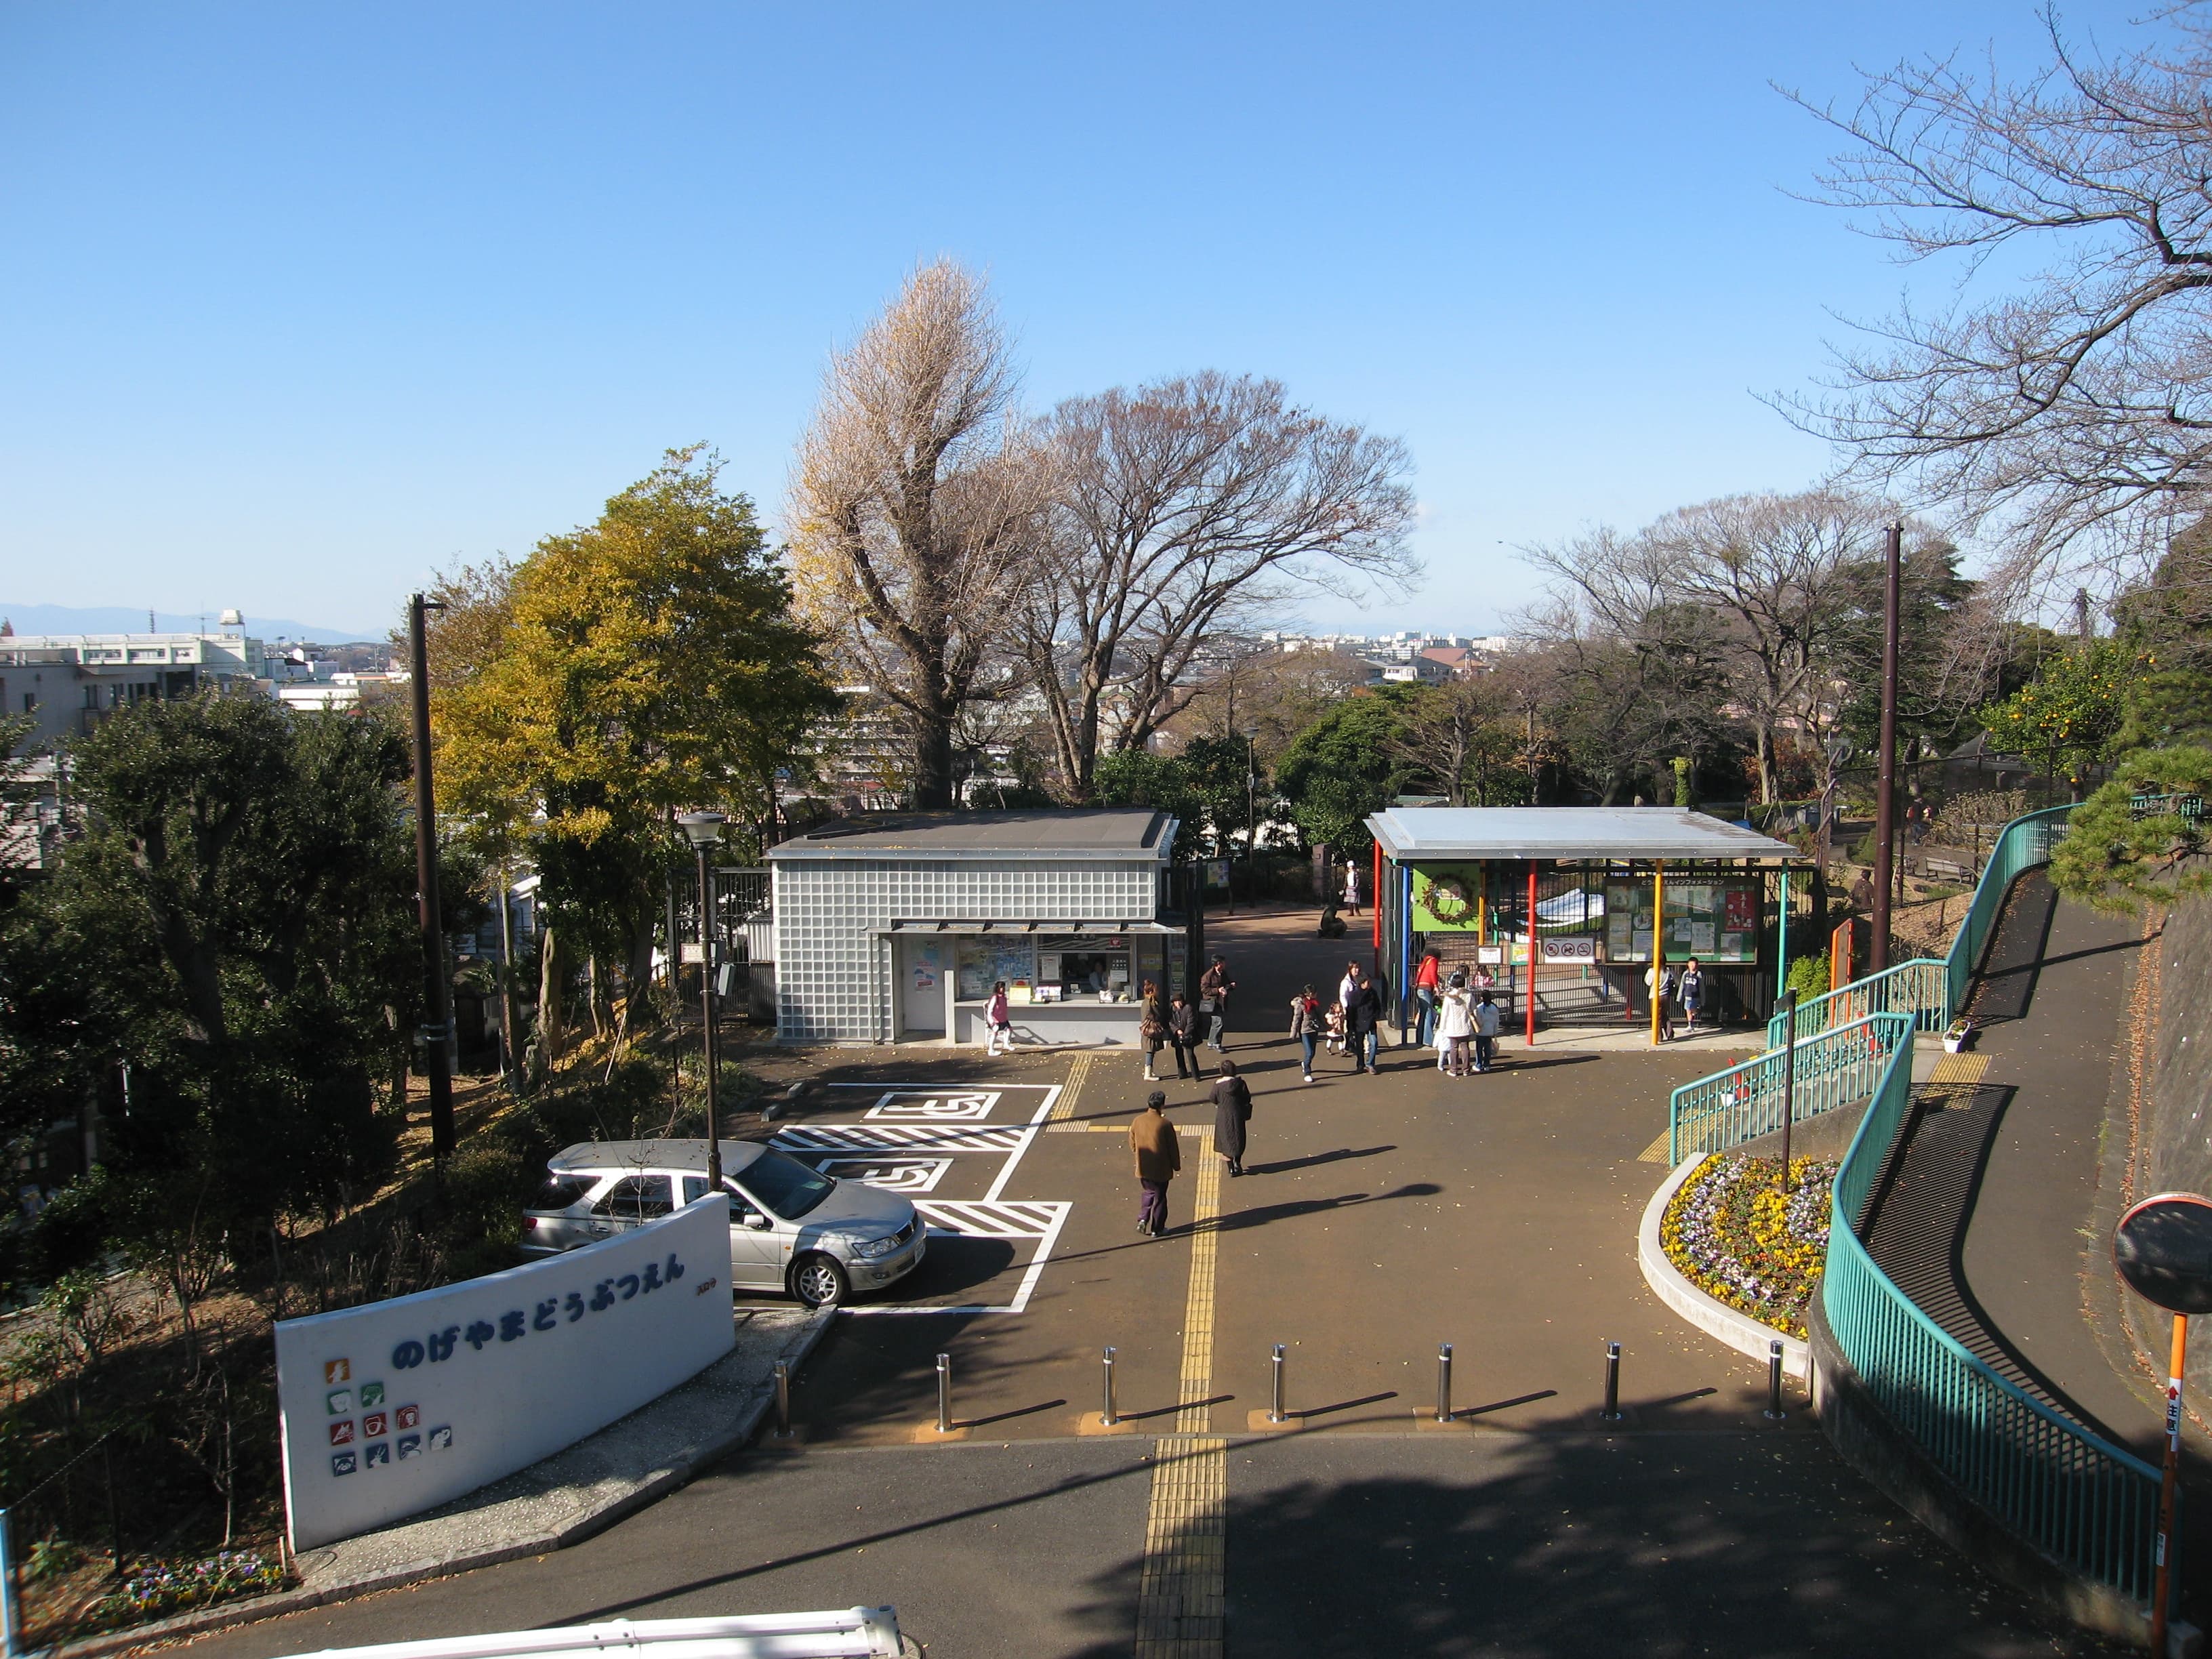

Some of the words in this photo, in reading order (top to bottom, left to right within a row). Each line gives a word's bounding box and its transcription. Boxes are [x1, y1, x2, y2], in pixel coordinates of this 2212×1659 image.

[391, 1252, 685, 1370] のげやまどうぶつえん
